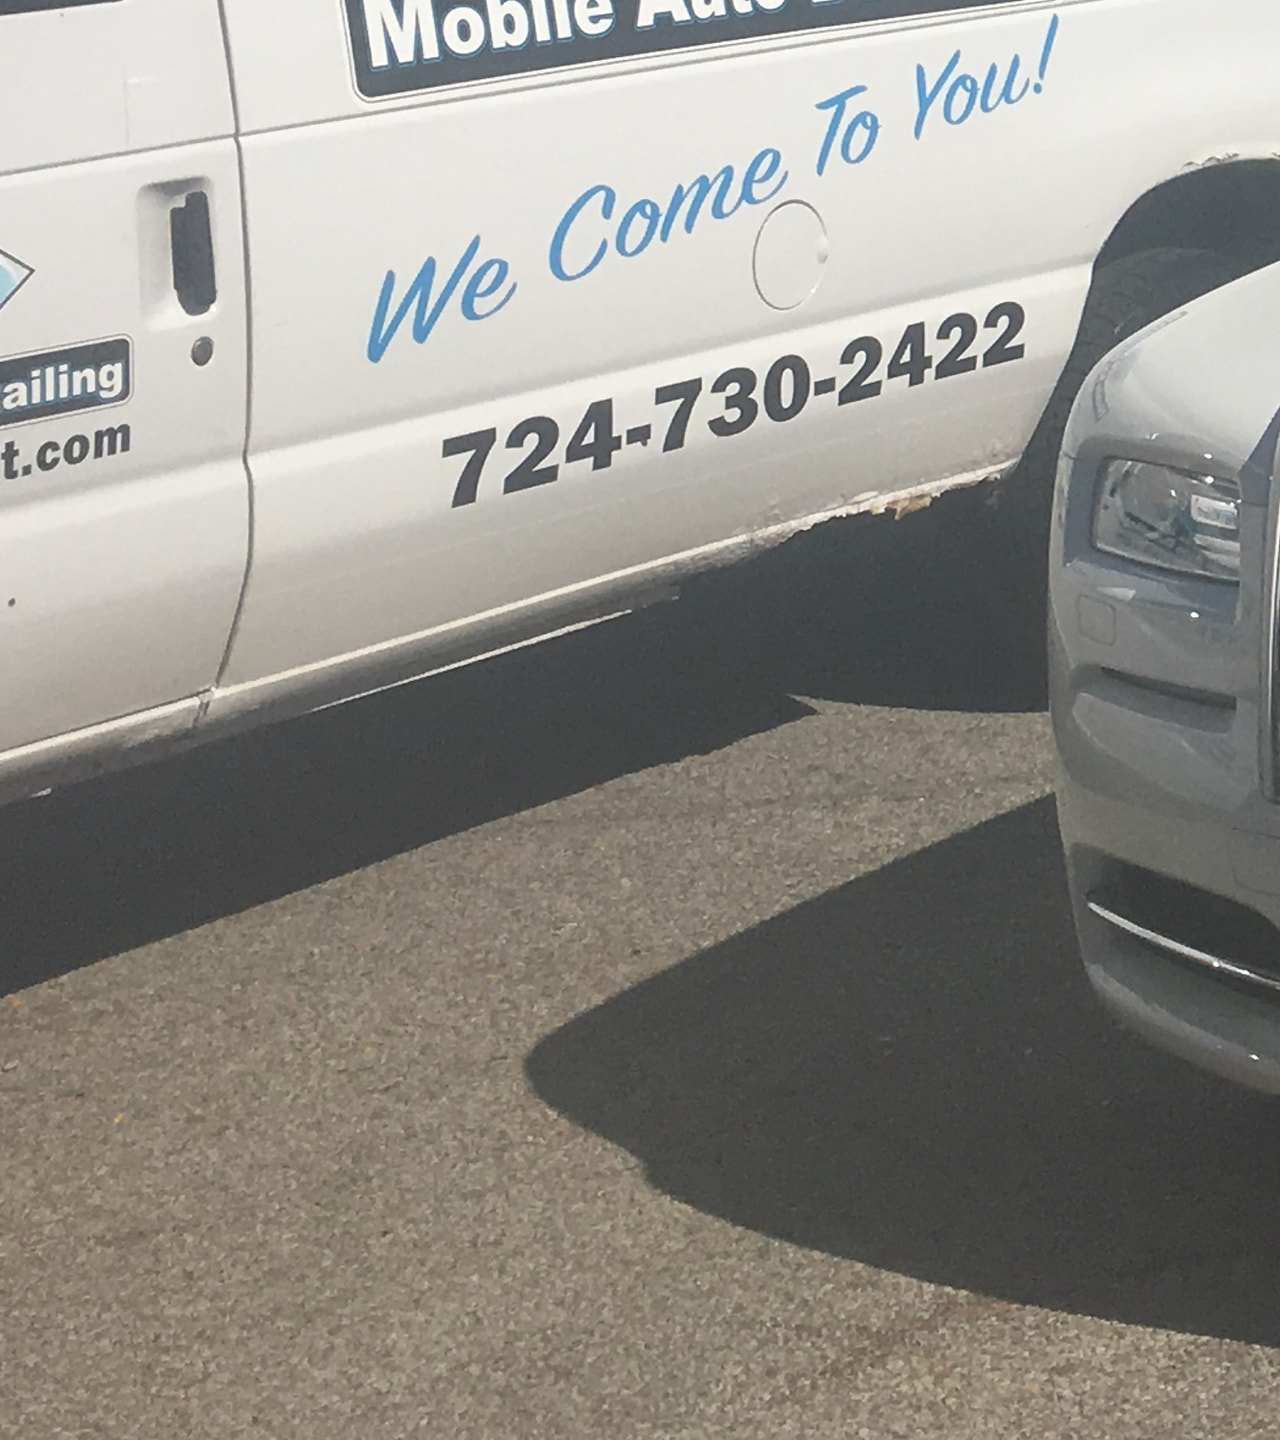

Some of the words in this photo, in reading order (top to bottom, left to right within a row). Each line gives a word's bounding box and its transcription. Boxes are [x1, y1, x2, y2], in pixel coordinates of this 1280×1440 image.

[366, 234, 518, 363] We
[549, 146, 790, 283] Come
[814, 84, 881, 175] To
[913, 13, 1059, 141] You!
[2, 362, 122, 410] ailing
[442, 301, 1027, 510] 724-730-2422
